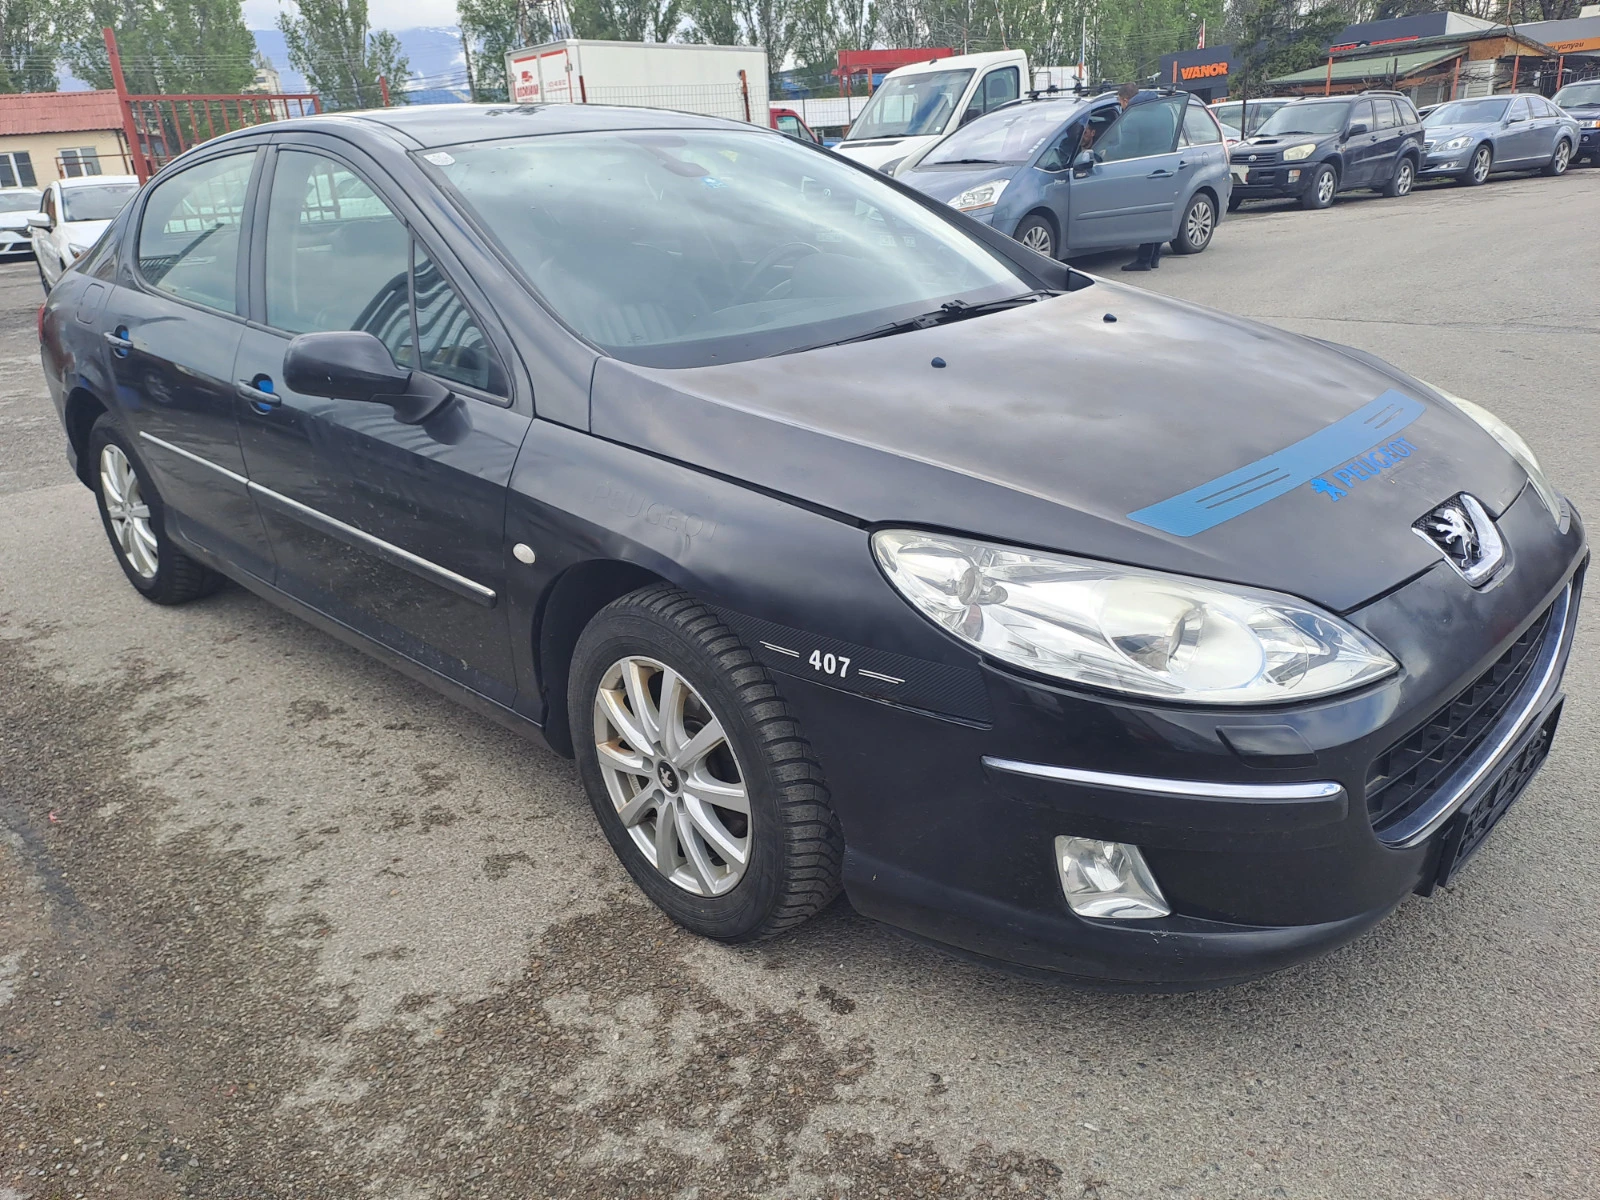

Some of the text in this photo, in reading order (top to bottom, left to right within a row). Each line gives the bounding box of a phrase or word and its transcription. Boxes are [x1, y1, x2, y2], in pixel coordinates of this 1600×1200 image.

[1180, 62, 1229, 80] VIANOR
[1333, 436, 1419, 488] PEUGEOT
[808, 649, 851, 678] 407
